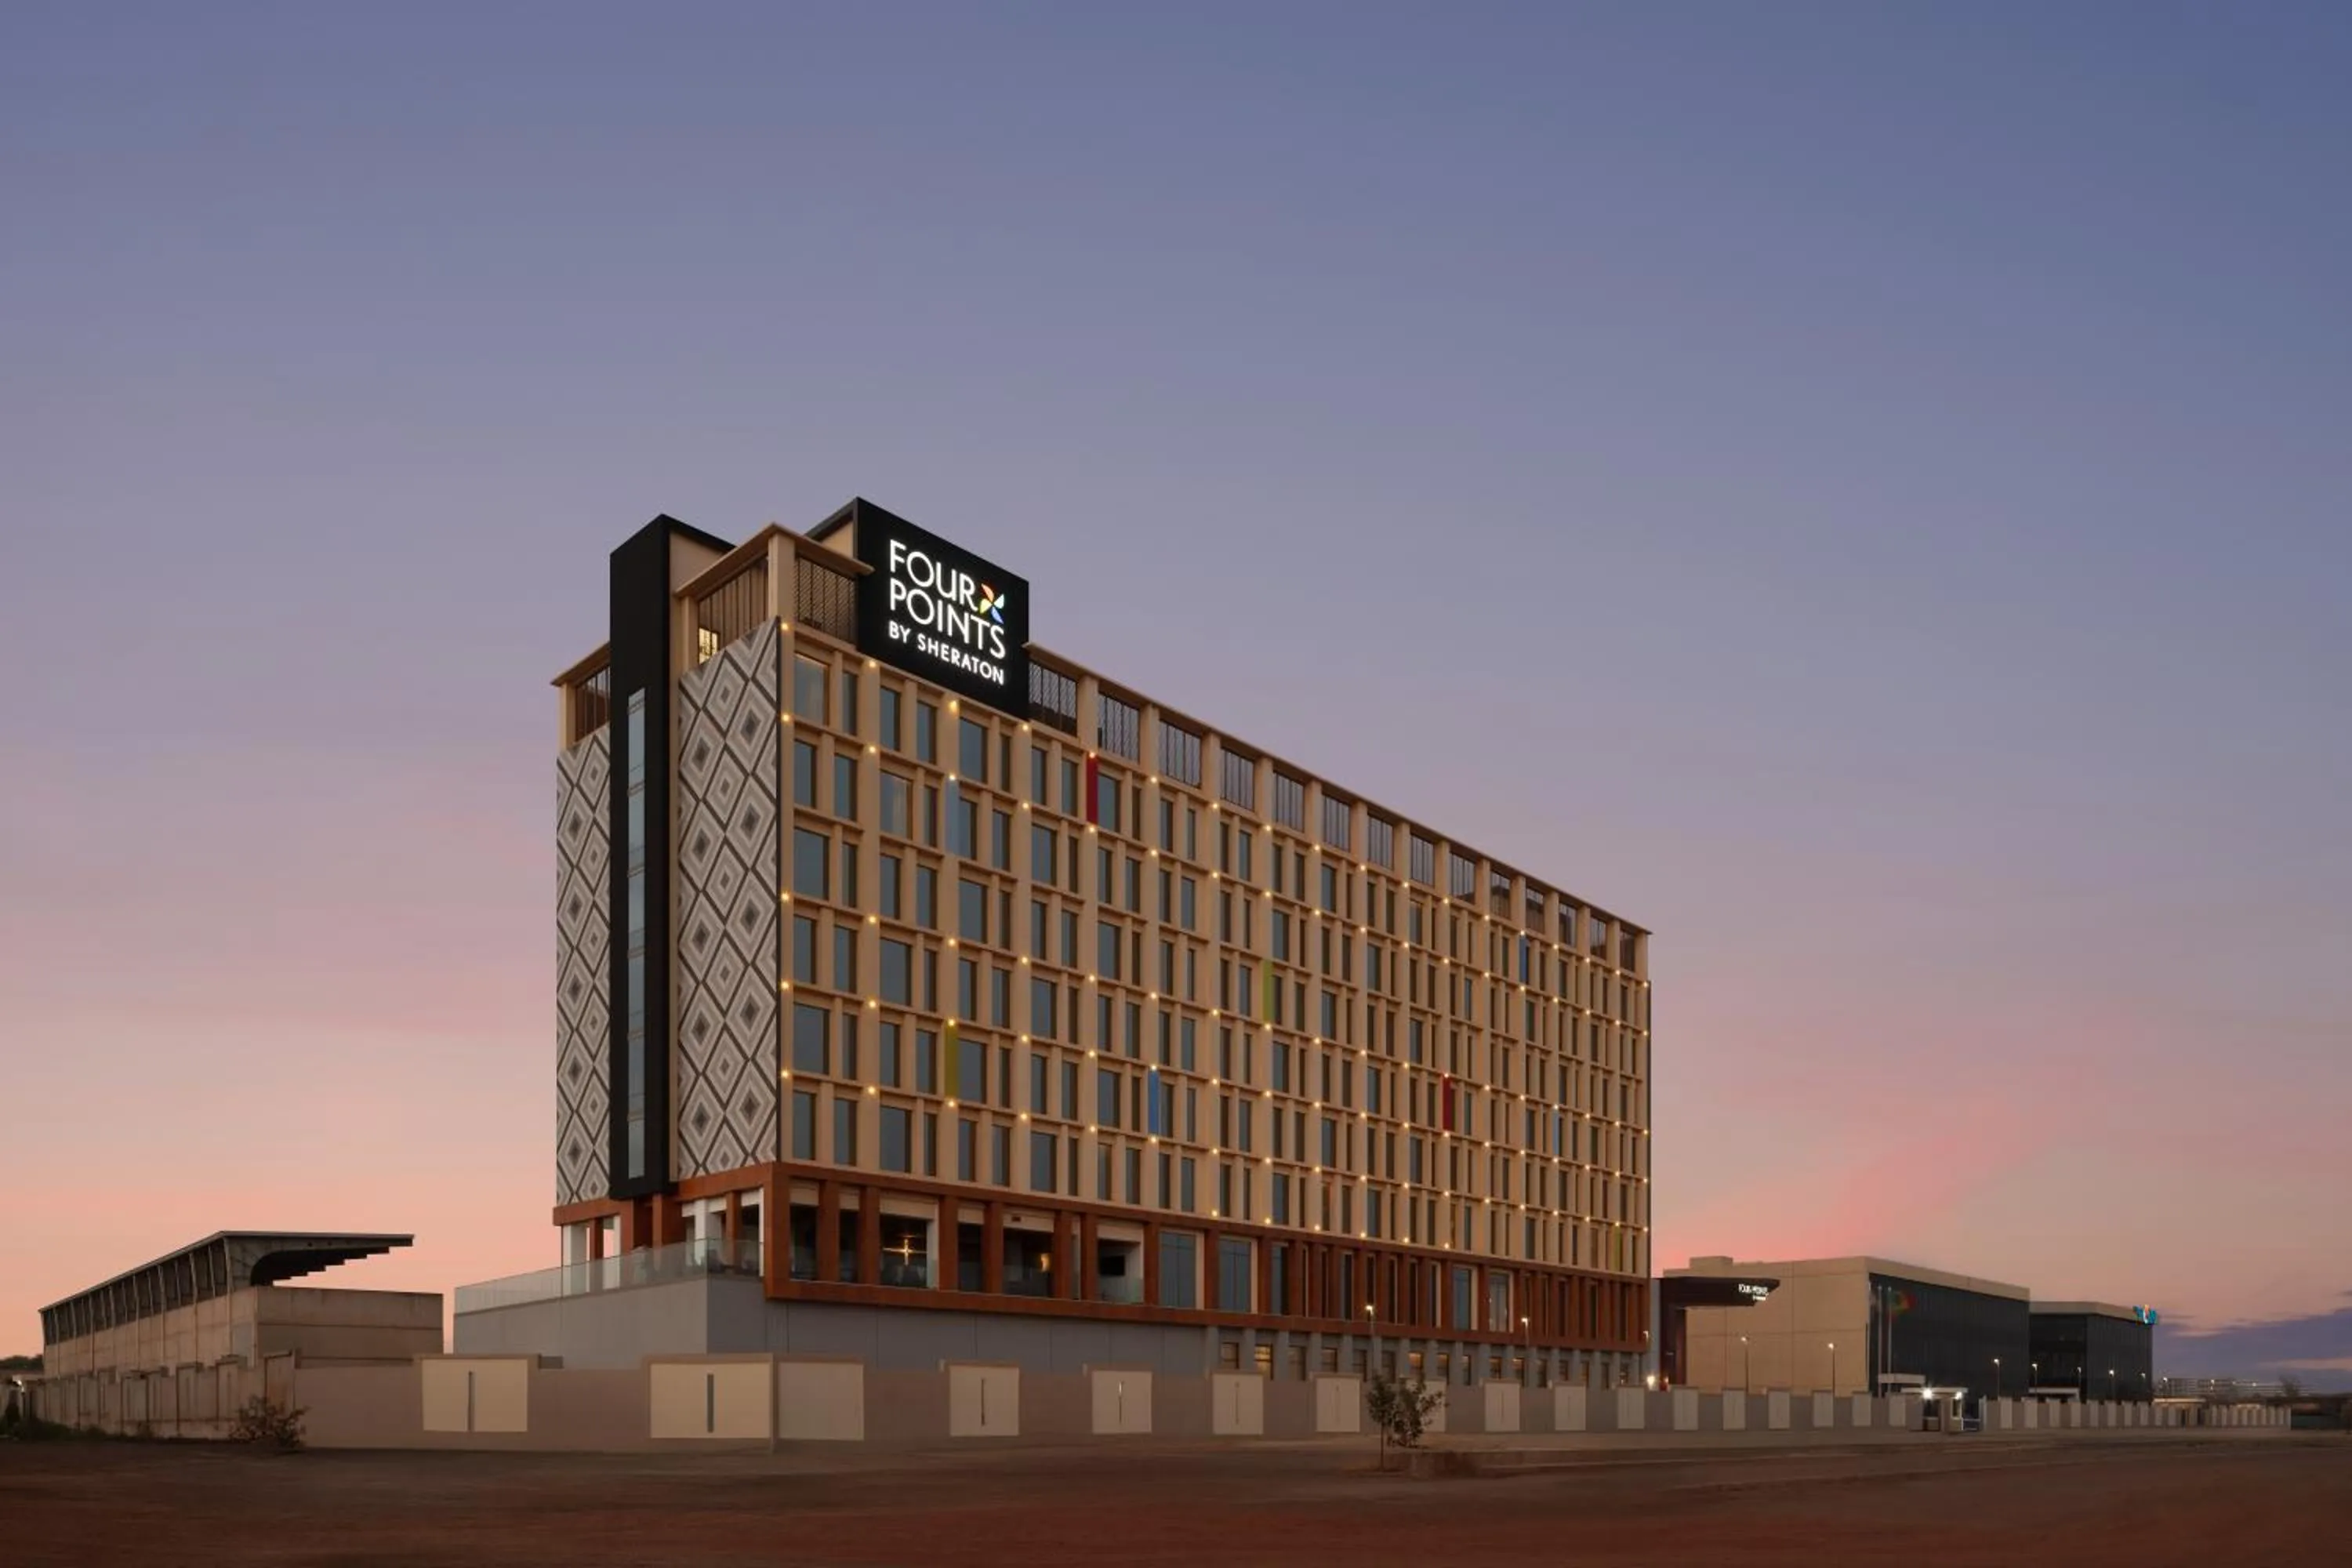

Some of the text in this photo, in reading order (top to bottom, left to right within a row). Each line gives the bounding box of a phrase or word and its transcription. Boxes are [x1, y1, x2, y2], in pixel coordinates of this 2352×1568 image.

[890, 539, 978, 612] FOUR
[889, 621, 1004, 685] BY SHERATON
[890, 578, 1006, 659] POINTS
